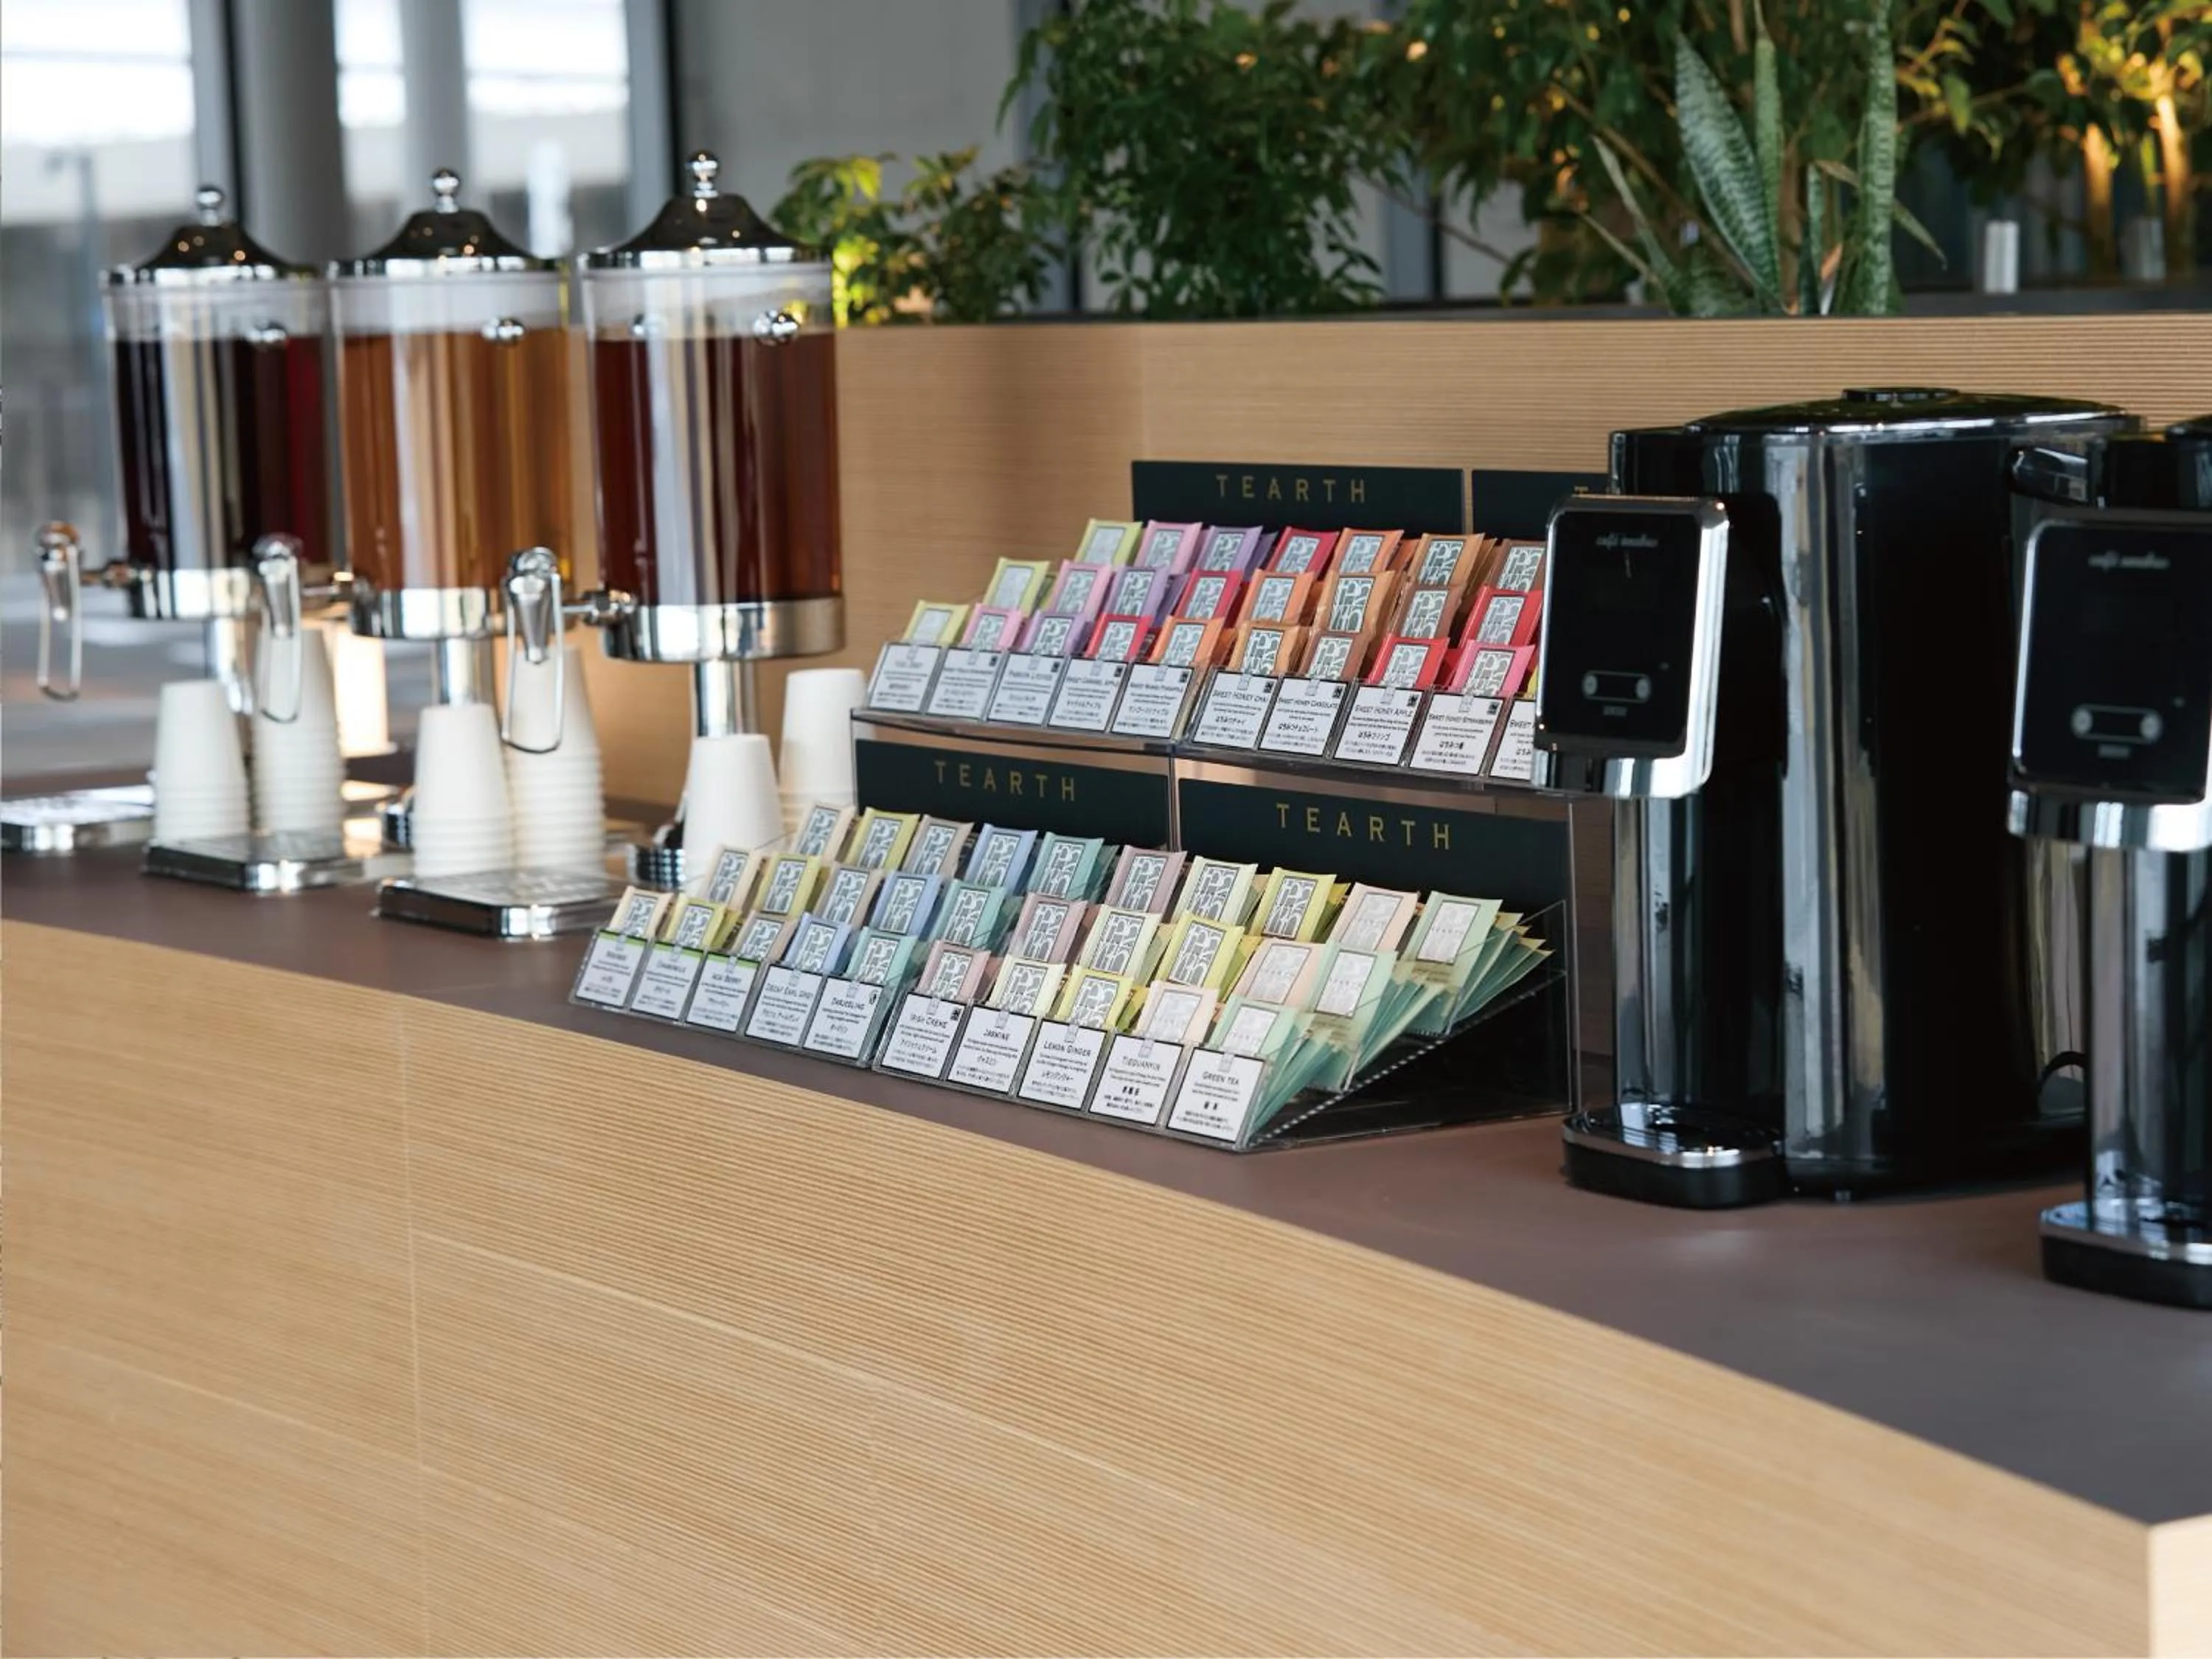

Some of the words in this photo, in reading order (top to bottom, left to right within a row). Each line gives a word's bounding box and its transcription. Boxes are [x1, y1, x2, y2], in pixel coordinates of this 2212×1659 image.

[1216, 474, 1366, 504] TEARTH
[934, 760, 1074, 802] TEARTH
[1276, 803, 1450, 850] TEARTH
[1043, 1040, 1066, 1052] LEMON
[1065, 1044, 1092, 1057] GINGER
[1200, 1071, 1226, 1083] GREEN
[1226, 1076, 1240, 1085] TEA
